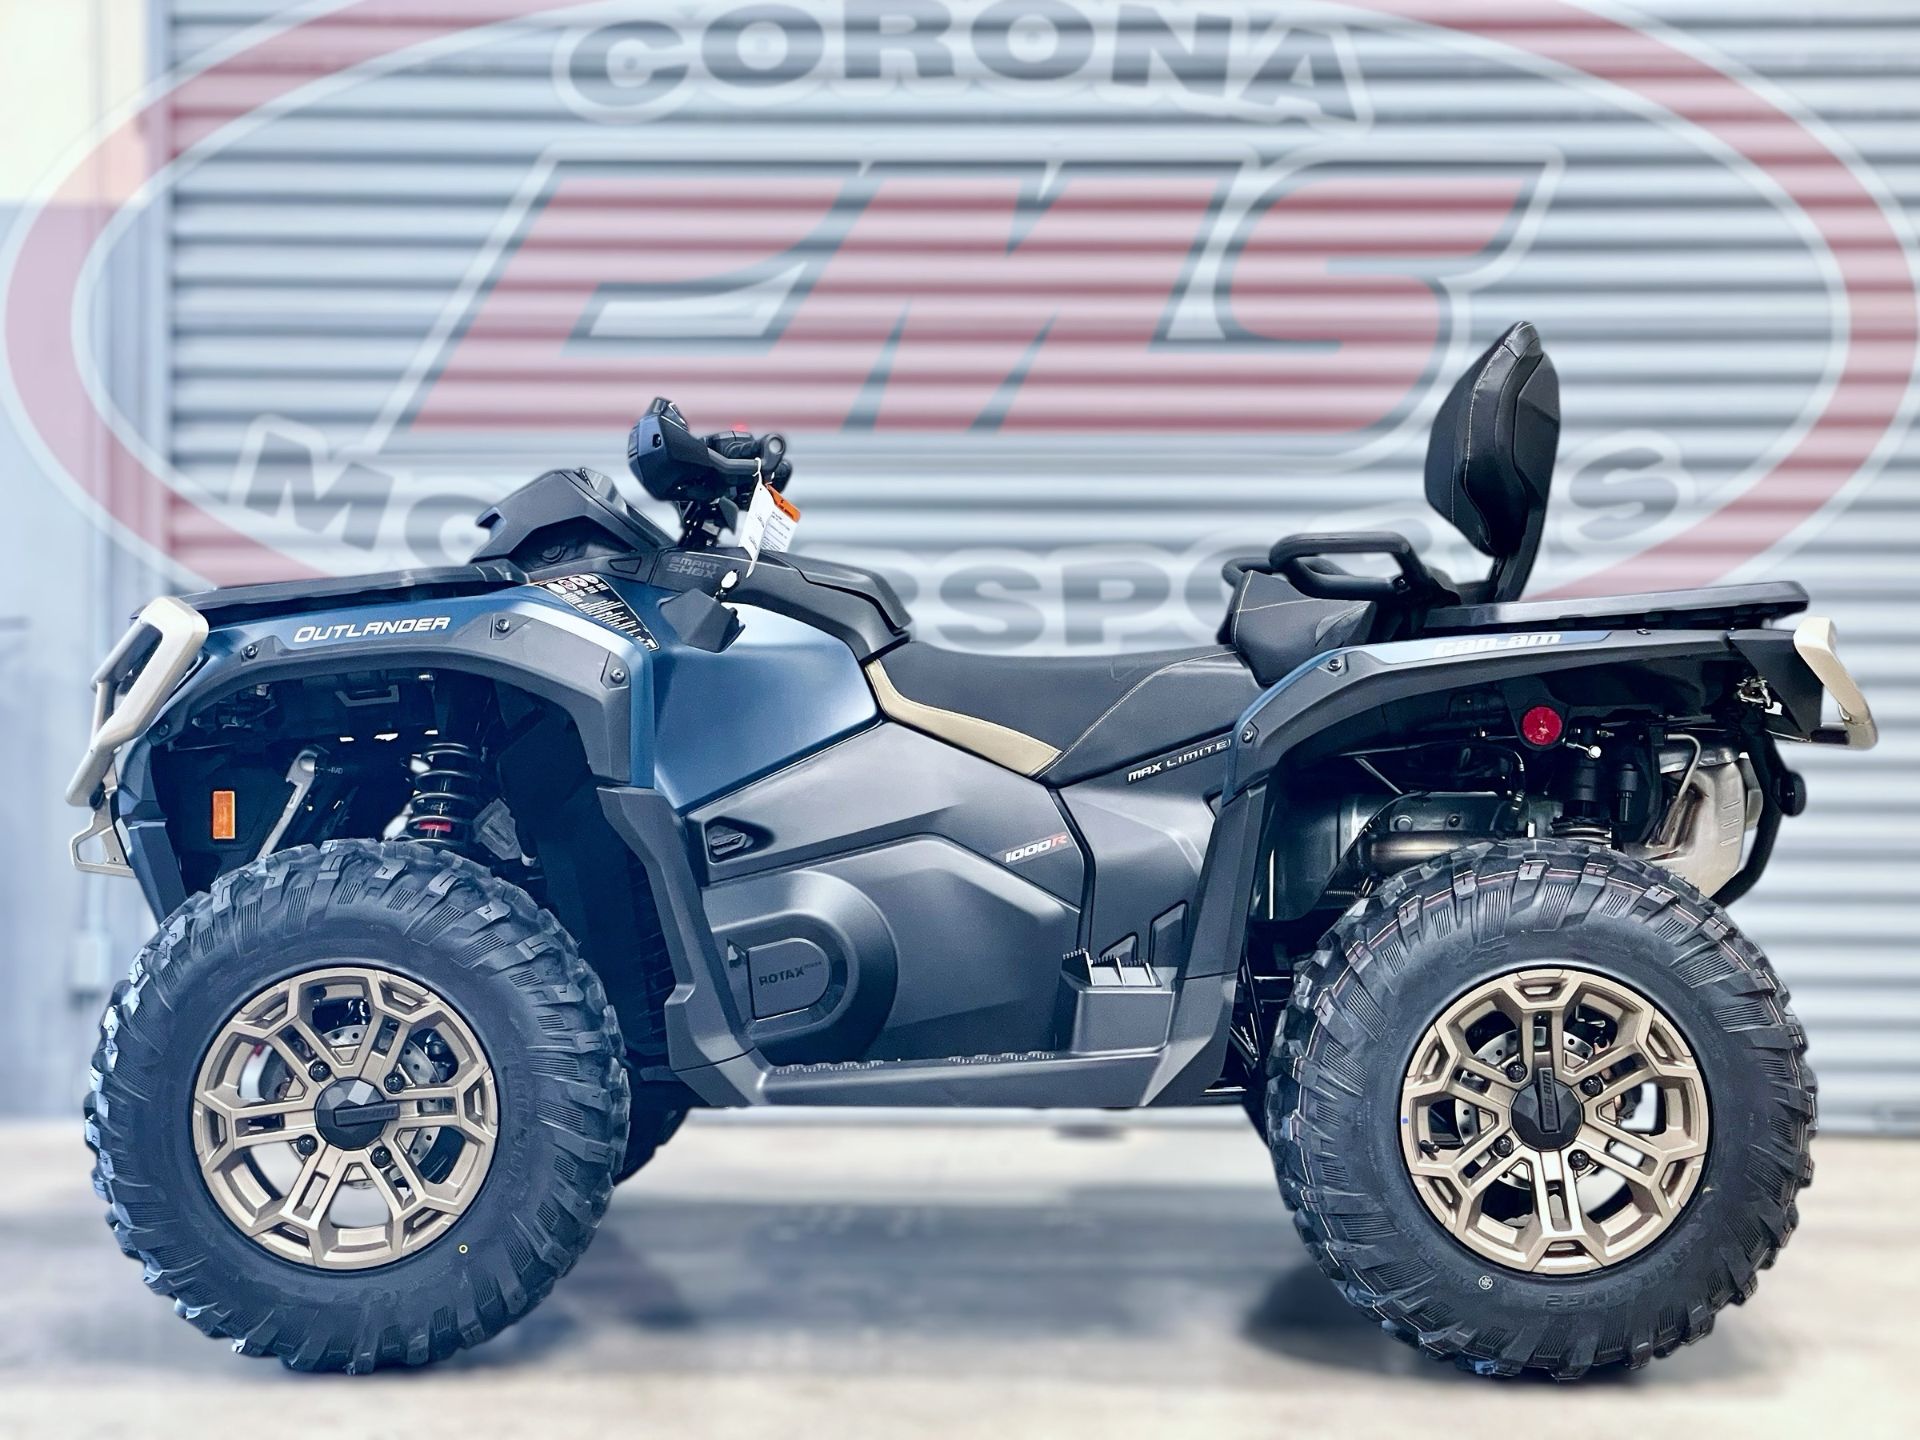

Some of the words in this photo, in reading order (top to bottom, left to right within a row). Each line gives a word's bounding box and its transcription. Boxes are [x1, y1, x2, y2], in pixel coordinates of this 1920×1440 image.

[670, 556, 720, 570] SMART
[293, 616, 451, 643] OUTLANDER
[1127, 762, 1162, 782] MAX
[1005, 835, 1067, 863] 1000R
[758, 967, 805, 986] ROTAX
